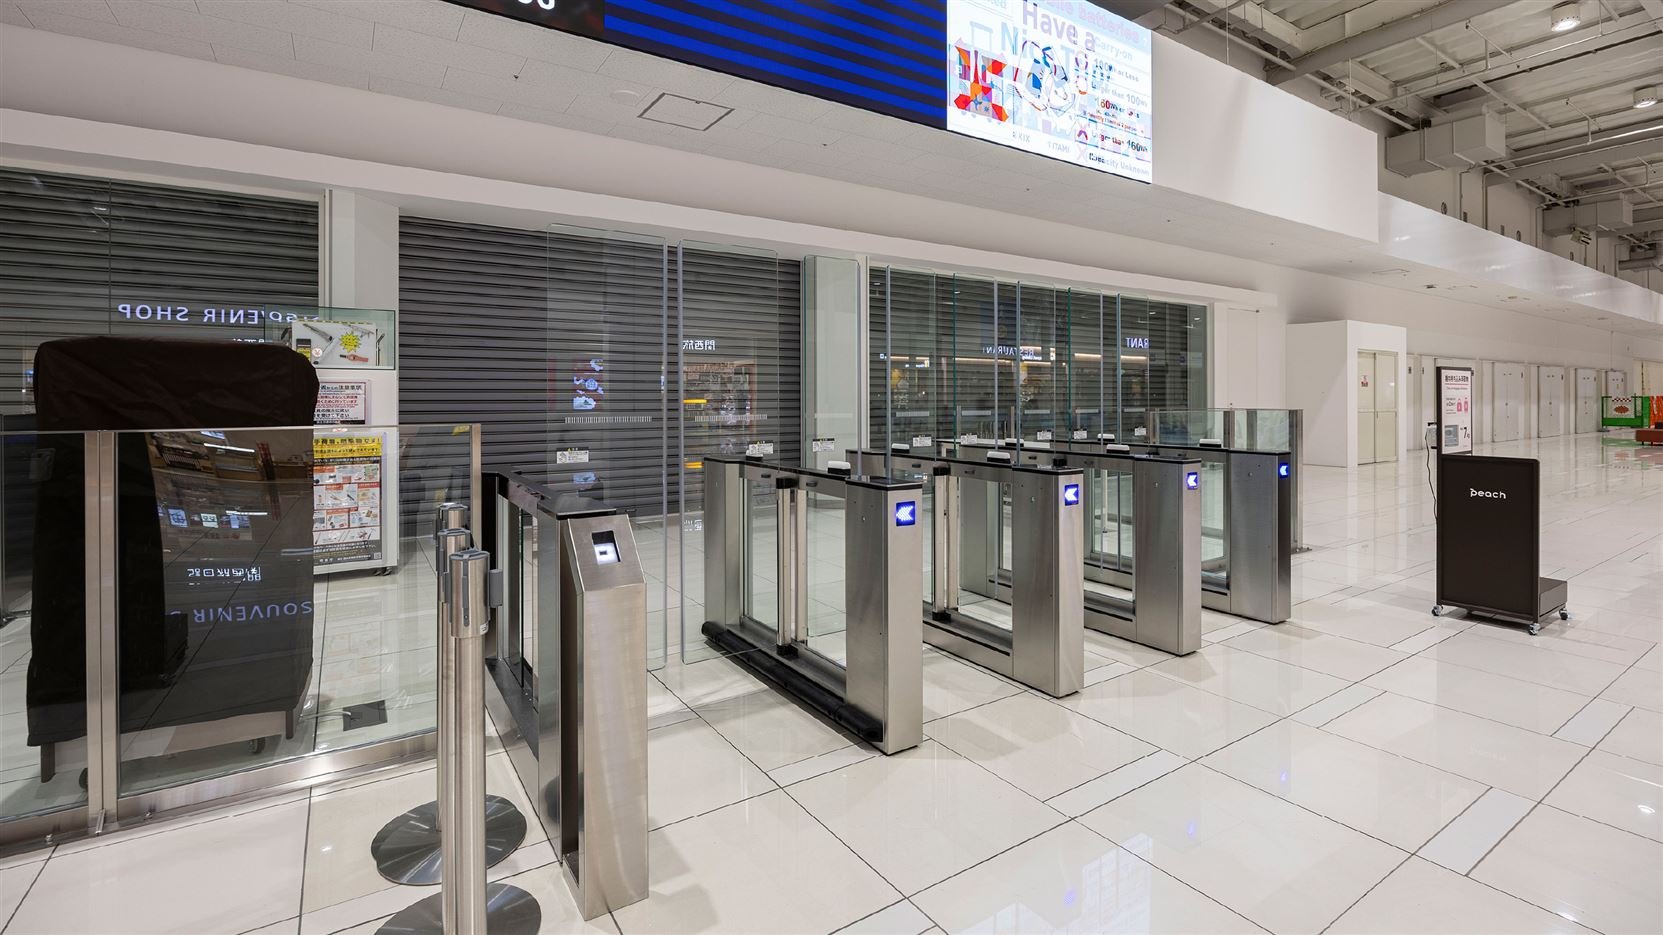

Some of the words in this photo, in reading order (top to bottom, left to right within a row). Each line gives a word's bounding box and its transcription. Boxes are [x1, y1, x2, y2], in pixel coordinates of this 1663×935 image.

[1022, 0, 1079, 46] Have
[1085, 31, 1095, 52] a
[1469, 488, 1506, 499] peach
